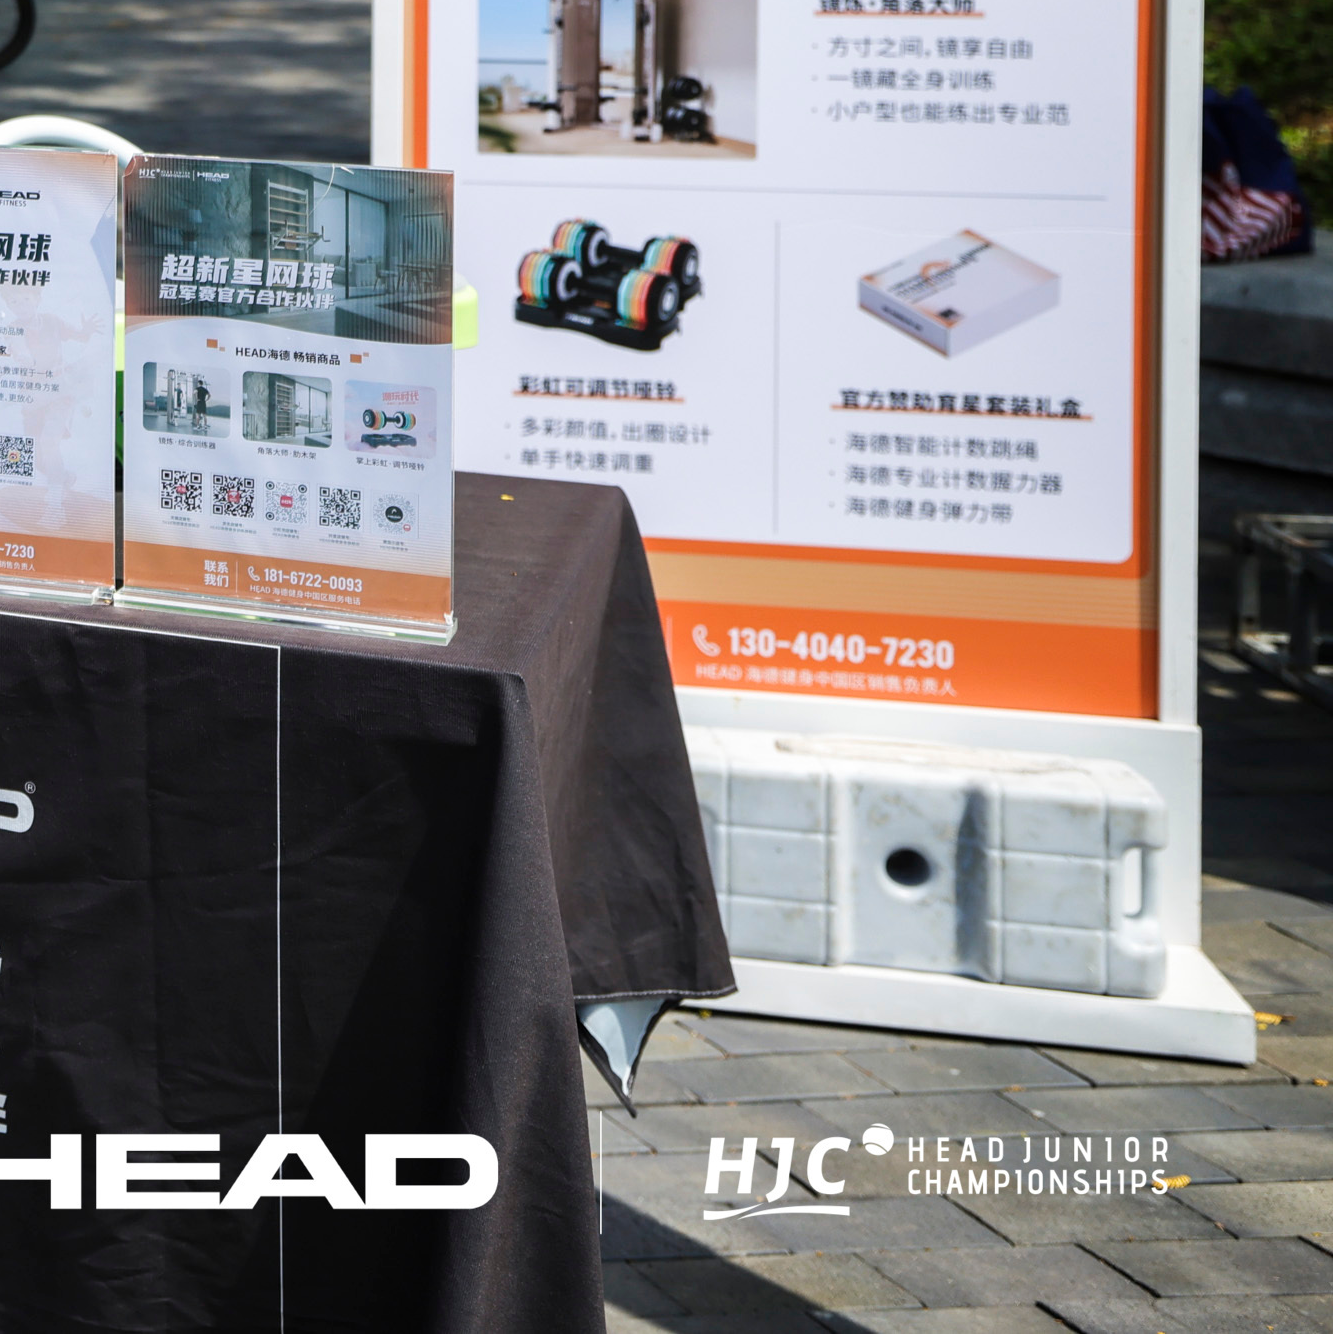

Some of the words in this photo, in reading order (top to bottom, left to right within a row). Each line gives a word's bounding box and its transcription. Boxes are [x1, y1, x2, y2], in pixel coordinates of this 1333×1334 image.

[0, 199, 27, 207] FITNESS
[161, 253, 335, 290] 超新星网球
[159, 283, 335, 310] 冠军赛官方合作伙伴
[235, 347, 290, 362] HEAD海德
[293, 350, 340, 366] 畅销商品
[204, 559, 229, 573] 联系
[204, 573, 229, 588] 我们
[263, 567, 363, 593] 181-6722-0093
[250, 585, 271, 594] HEAD
[272, 587, 361, 606] 海德健身中国区服务电话
[727, 627, 954, 670] 130-4040-7230
[695, 664, 743, 681] HEAD
